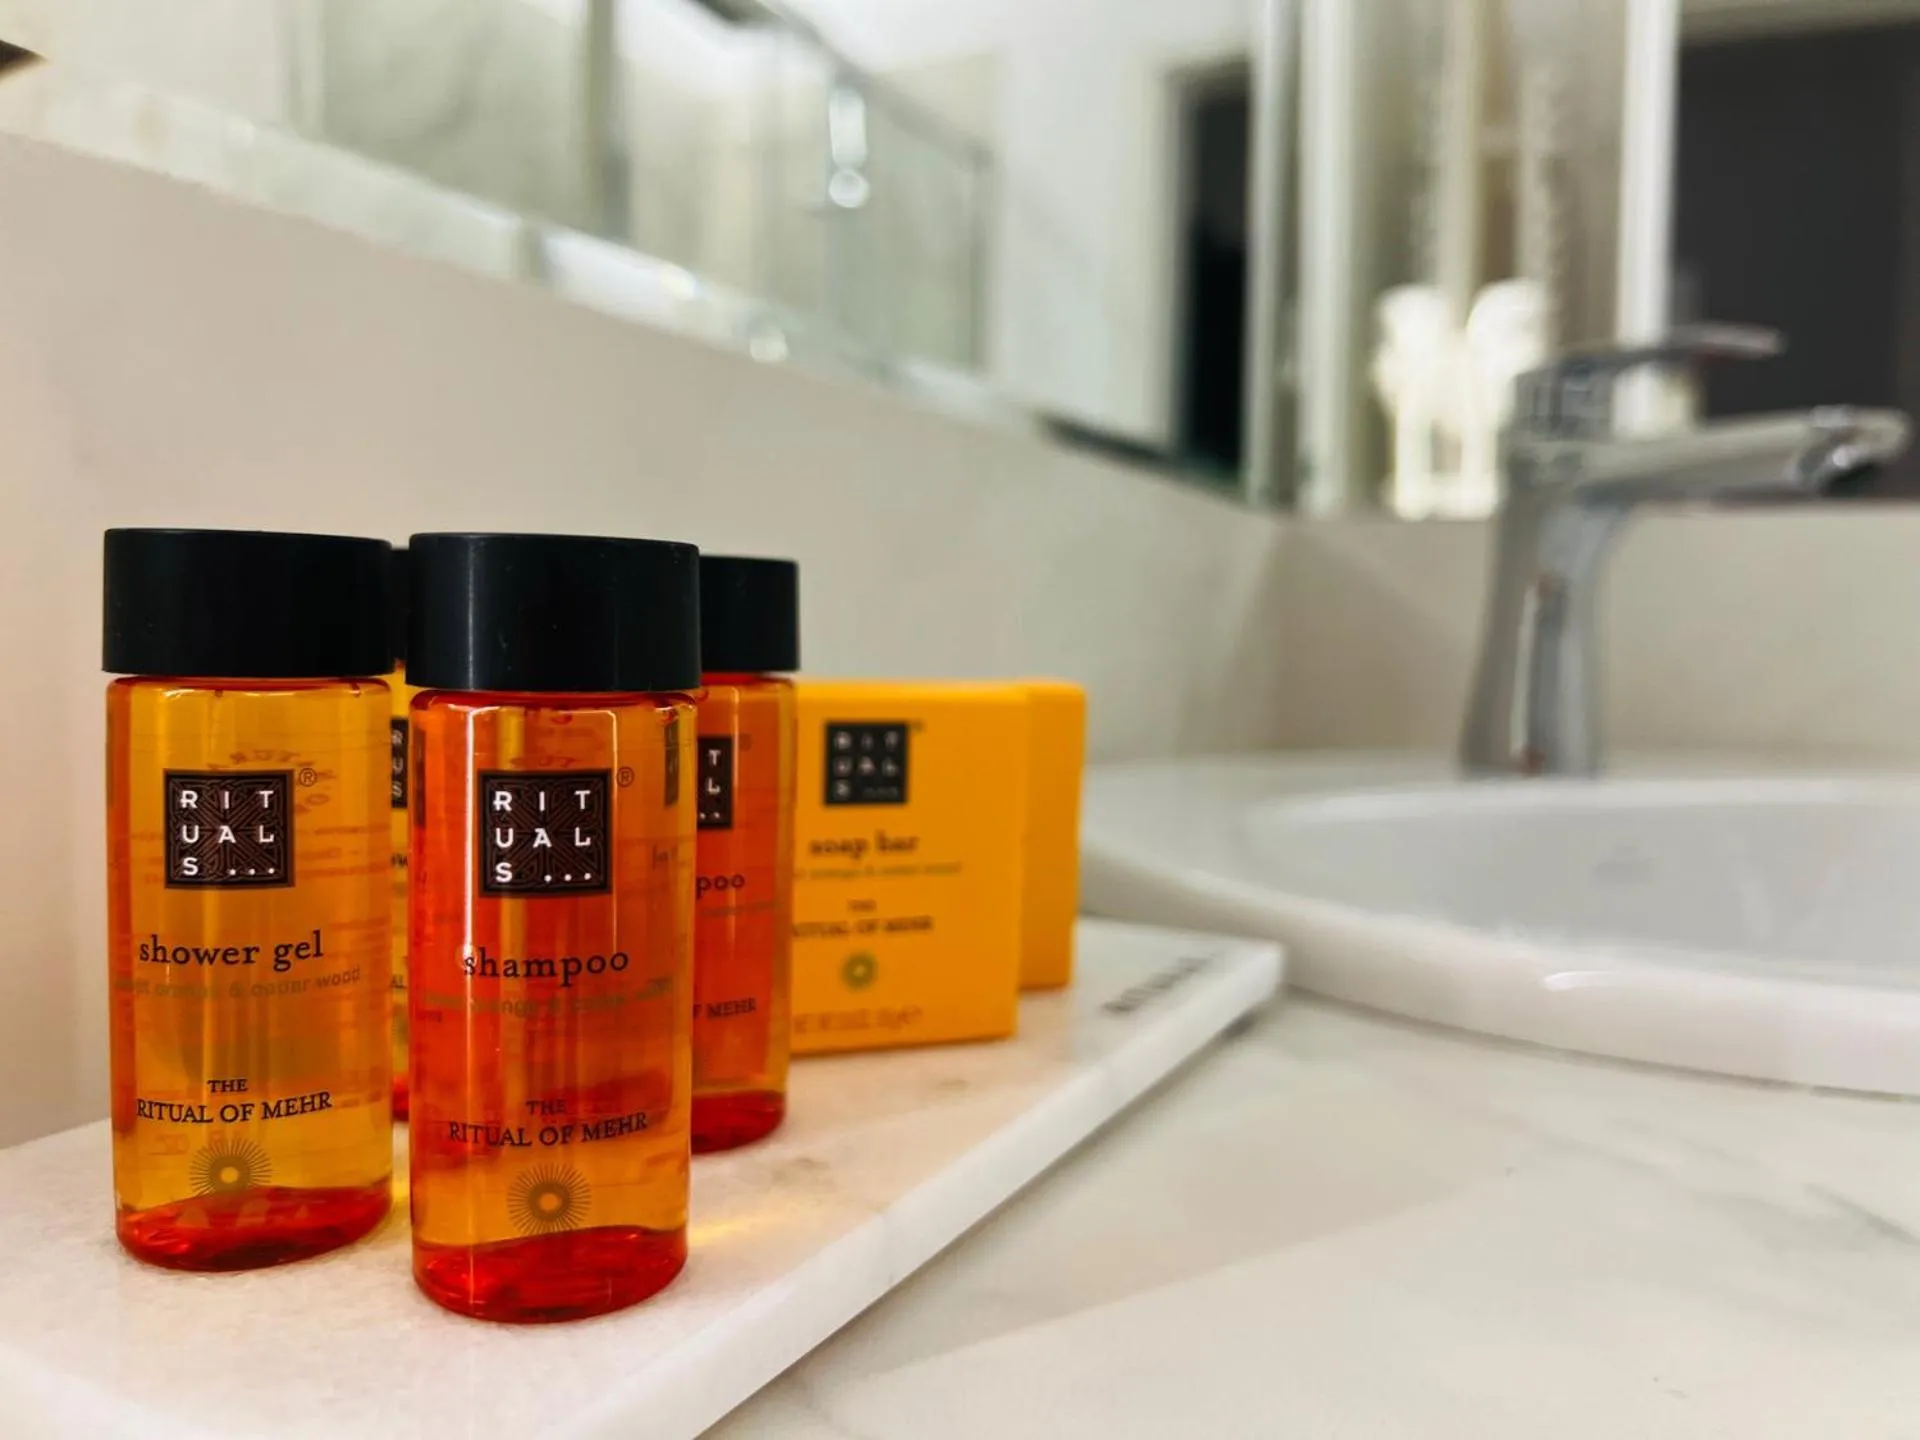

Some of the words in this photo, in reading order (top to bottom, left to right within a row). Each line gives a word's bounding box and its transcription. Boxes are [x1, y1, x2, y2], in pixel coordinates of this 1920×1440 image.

[139, 935, 260, 965] shower
[273, 930, 324, 971] gel
[464, 947, 629, 986] shampoo
[315, 966, 361, 990] wood
[207, 1079, 248, 1093] THE
[137, 1099, 213, 1123] RITUAL
[220, 1104, 255, 1122] OF
[261, 1091, 332, 1120] MEHR
[526, 1099, 566, 1115] THE
[450, 1121, 532, 1147] RITUAL
[539, 1126, 576, 1145] OF
[582, 1112, 648, 1142] MEHR
